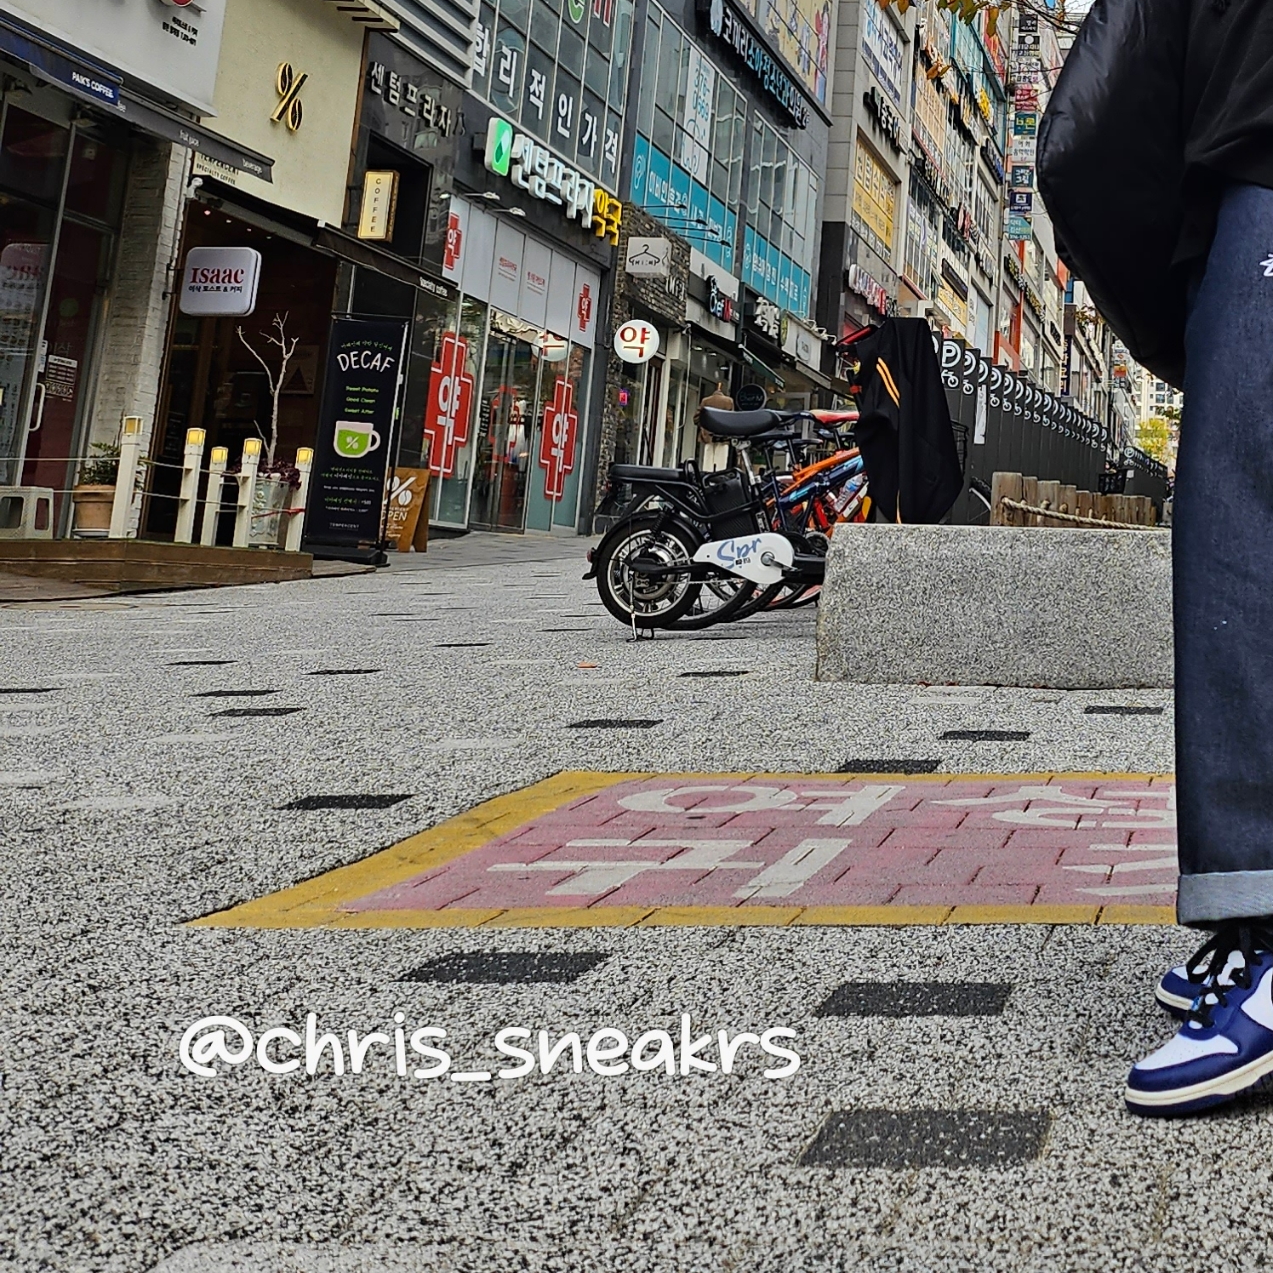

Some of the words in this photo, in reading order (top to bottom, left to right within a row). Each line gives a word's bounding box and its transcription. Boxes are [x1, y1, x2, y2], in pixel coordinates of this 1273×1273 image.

[370, 62, 451, 136] 센텀프라자
[369, 177, 383, 234] COFFEE
[511, 134, 594, 228] 센텀프라자
[593, 188, 622, 246] 약국
[447, 228, 459, 254] 약
[337, 349, 395, 374] DECAF
[620, 327, 650, 357] 약
[438, 378, 460, 445] 약
[552, 412, 570, 473] 약
